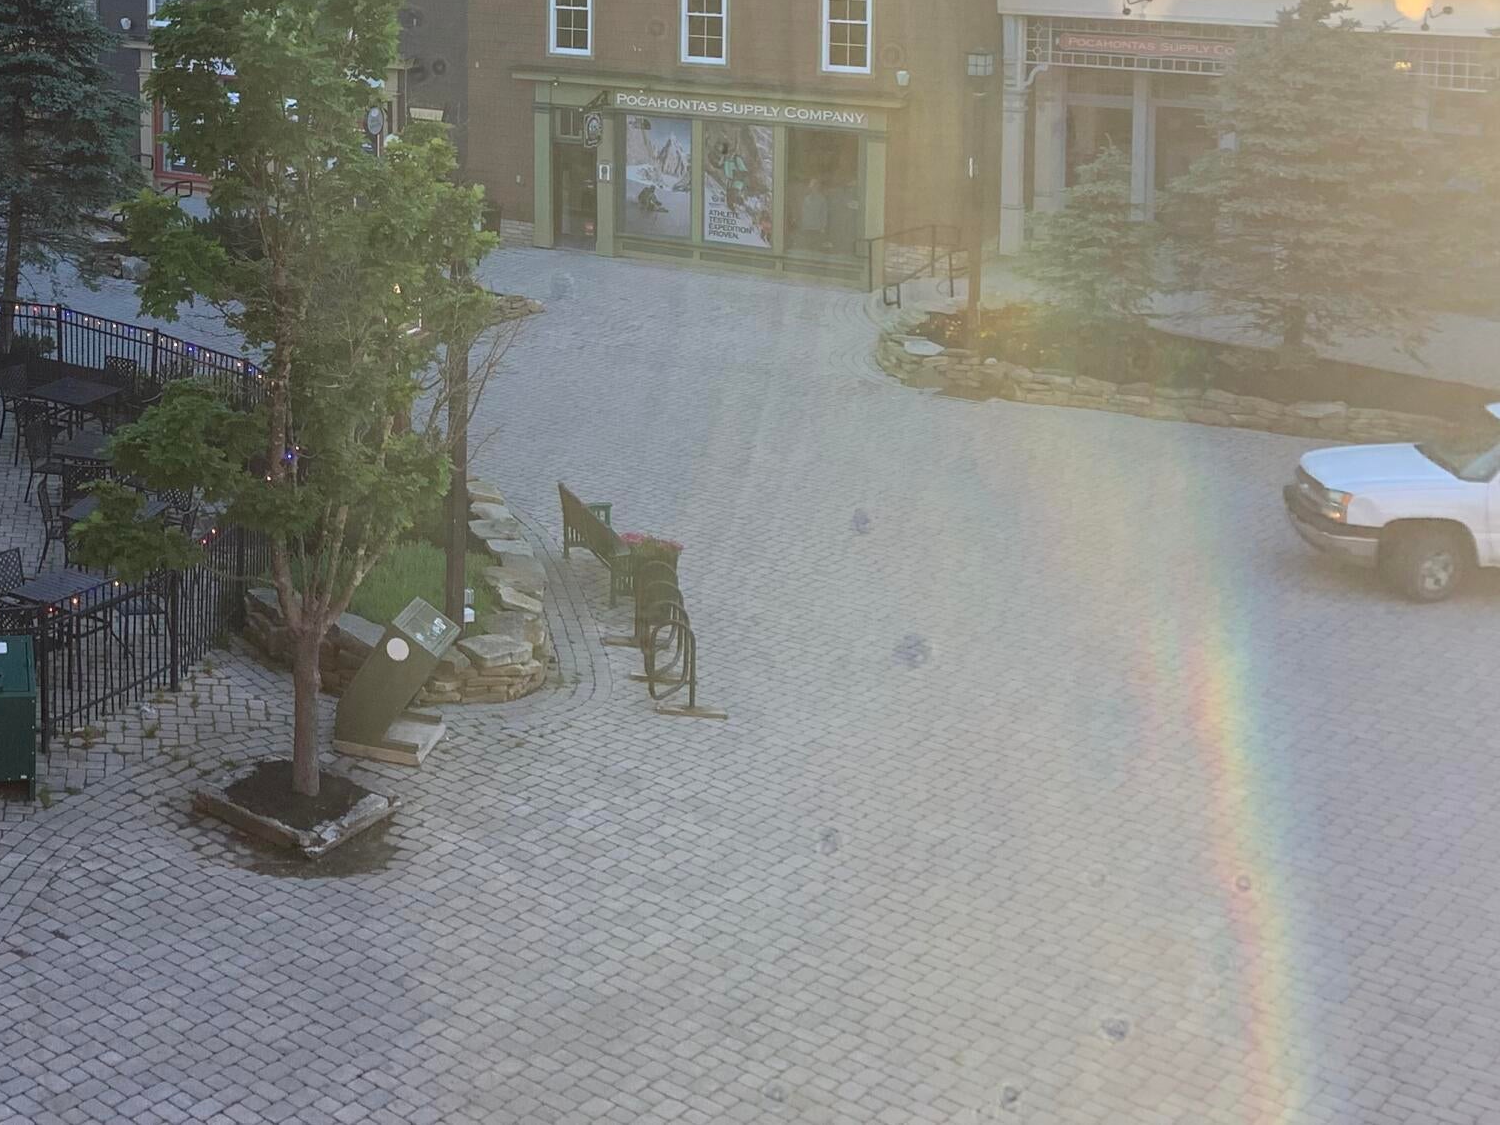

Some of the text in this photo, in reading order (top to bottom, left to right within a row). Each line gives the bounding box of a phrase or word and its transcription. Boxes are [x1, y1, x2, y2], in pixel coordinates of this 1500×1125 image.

[1068, 36, 1156, 52] POCAHONTAS
[1161, 42, 1211, 54] SUPPLY
[616, 93, 865, 124] POCAHONTAS SUPPLY COMPANY
